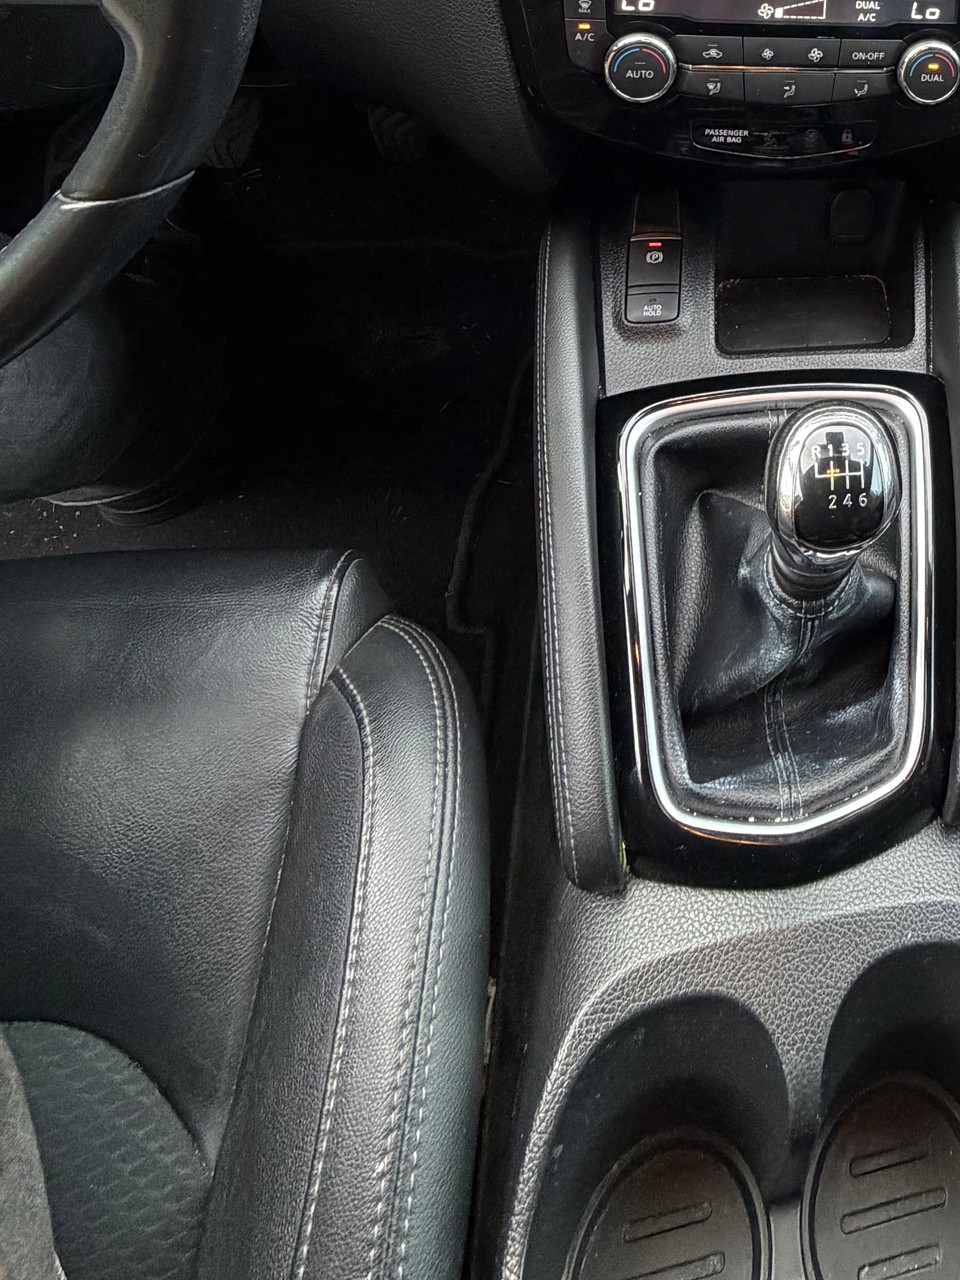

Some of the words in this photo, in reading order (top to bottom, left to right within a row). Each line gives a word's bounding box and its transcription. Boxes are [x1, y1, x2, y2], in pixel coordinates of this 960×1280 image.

[855, 0, 881, 10] DUAL
[857, 12, 876, 22] A/C
[574, 32, 595, 42] A/C
[851, 51, 885, 61] ON-OFF
[625, 69, 654, 79] AUTO
[920, 73, 944, 82] DUAL
[704, 128, 749, 137] PASSENGER
[726, 136, 742, 144] BAG
[811, 445, 821, 458] R
[828, 444, 834, 457] 1
[841, 442, 850, 456] 3
[856, 442, 865, 455] 5
[828, 495, 837, 509] 2
[842, 493, 852, 507] 4
[858, 493, 868, 507] 6
